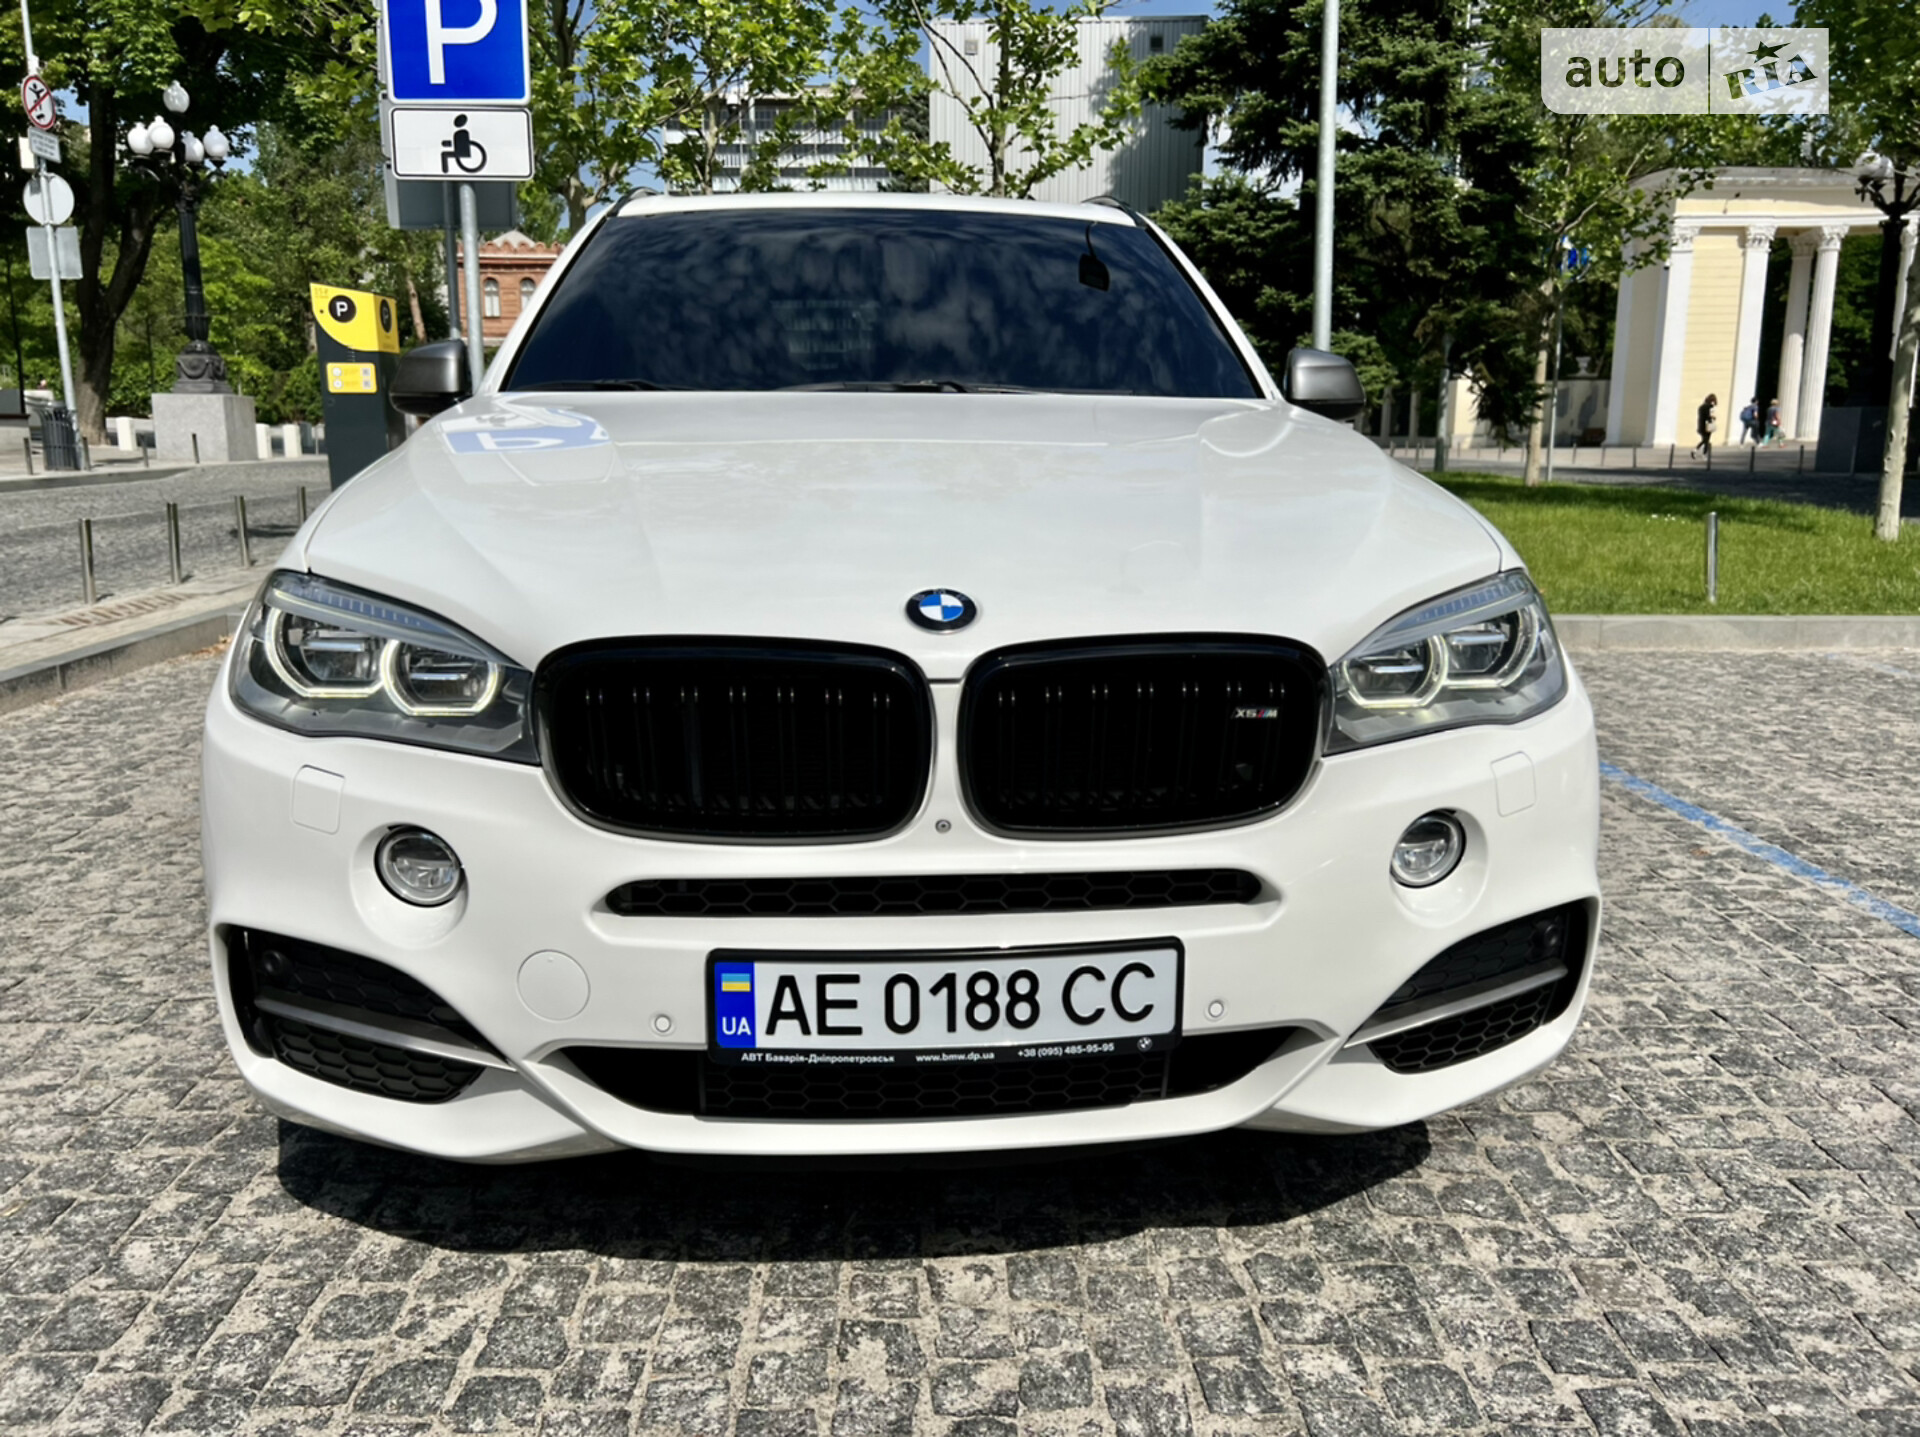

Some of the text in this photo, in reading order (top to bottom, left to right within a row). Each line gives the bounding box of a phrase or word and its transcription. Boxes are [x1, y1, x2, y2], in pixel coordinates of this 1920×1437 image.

[424, 0, 497, 84] P
[336, 301, 348, 317] P
[765, 962, 1155, 1036] AE 0188 CC
[721, 1017, 752, 1036] UA
[741, 1052, 763, 1062] АВТ
[915, 1051, 995, 1062] www.bmw.dp.ua
[1018, 1042, 1115, 1058] +38 (095) 485-95-95
